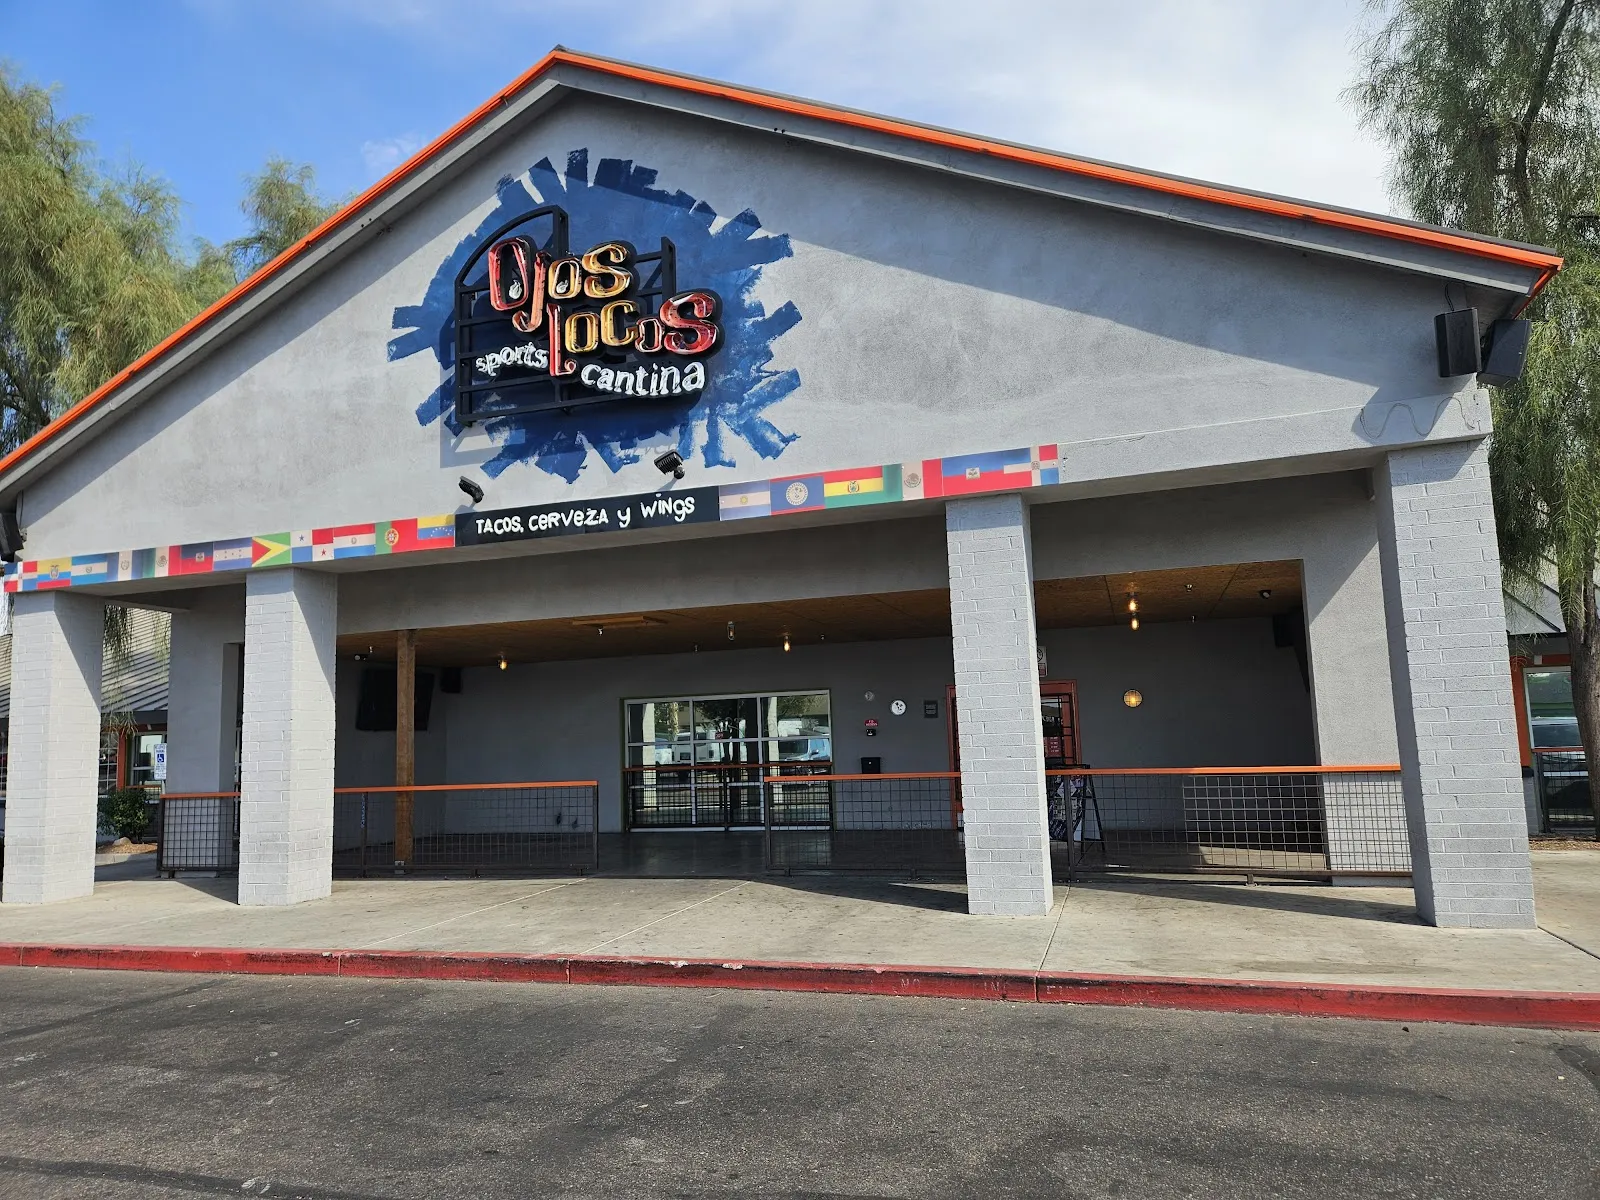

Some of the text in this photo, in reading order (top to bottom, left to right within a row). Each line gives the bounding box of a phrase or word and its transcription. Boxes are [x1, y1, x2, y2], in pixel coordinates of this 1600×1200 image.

[475, 342, 549, 377] sports
[580, 361, 706, 397] cantina
[476, 515, 524, 536] TACOS,
